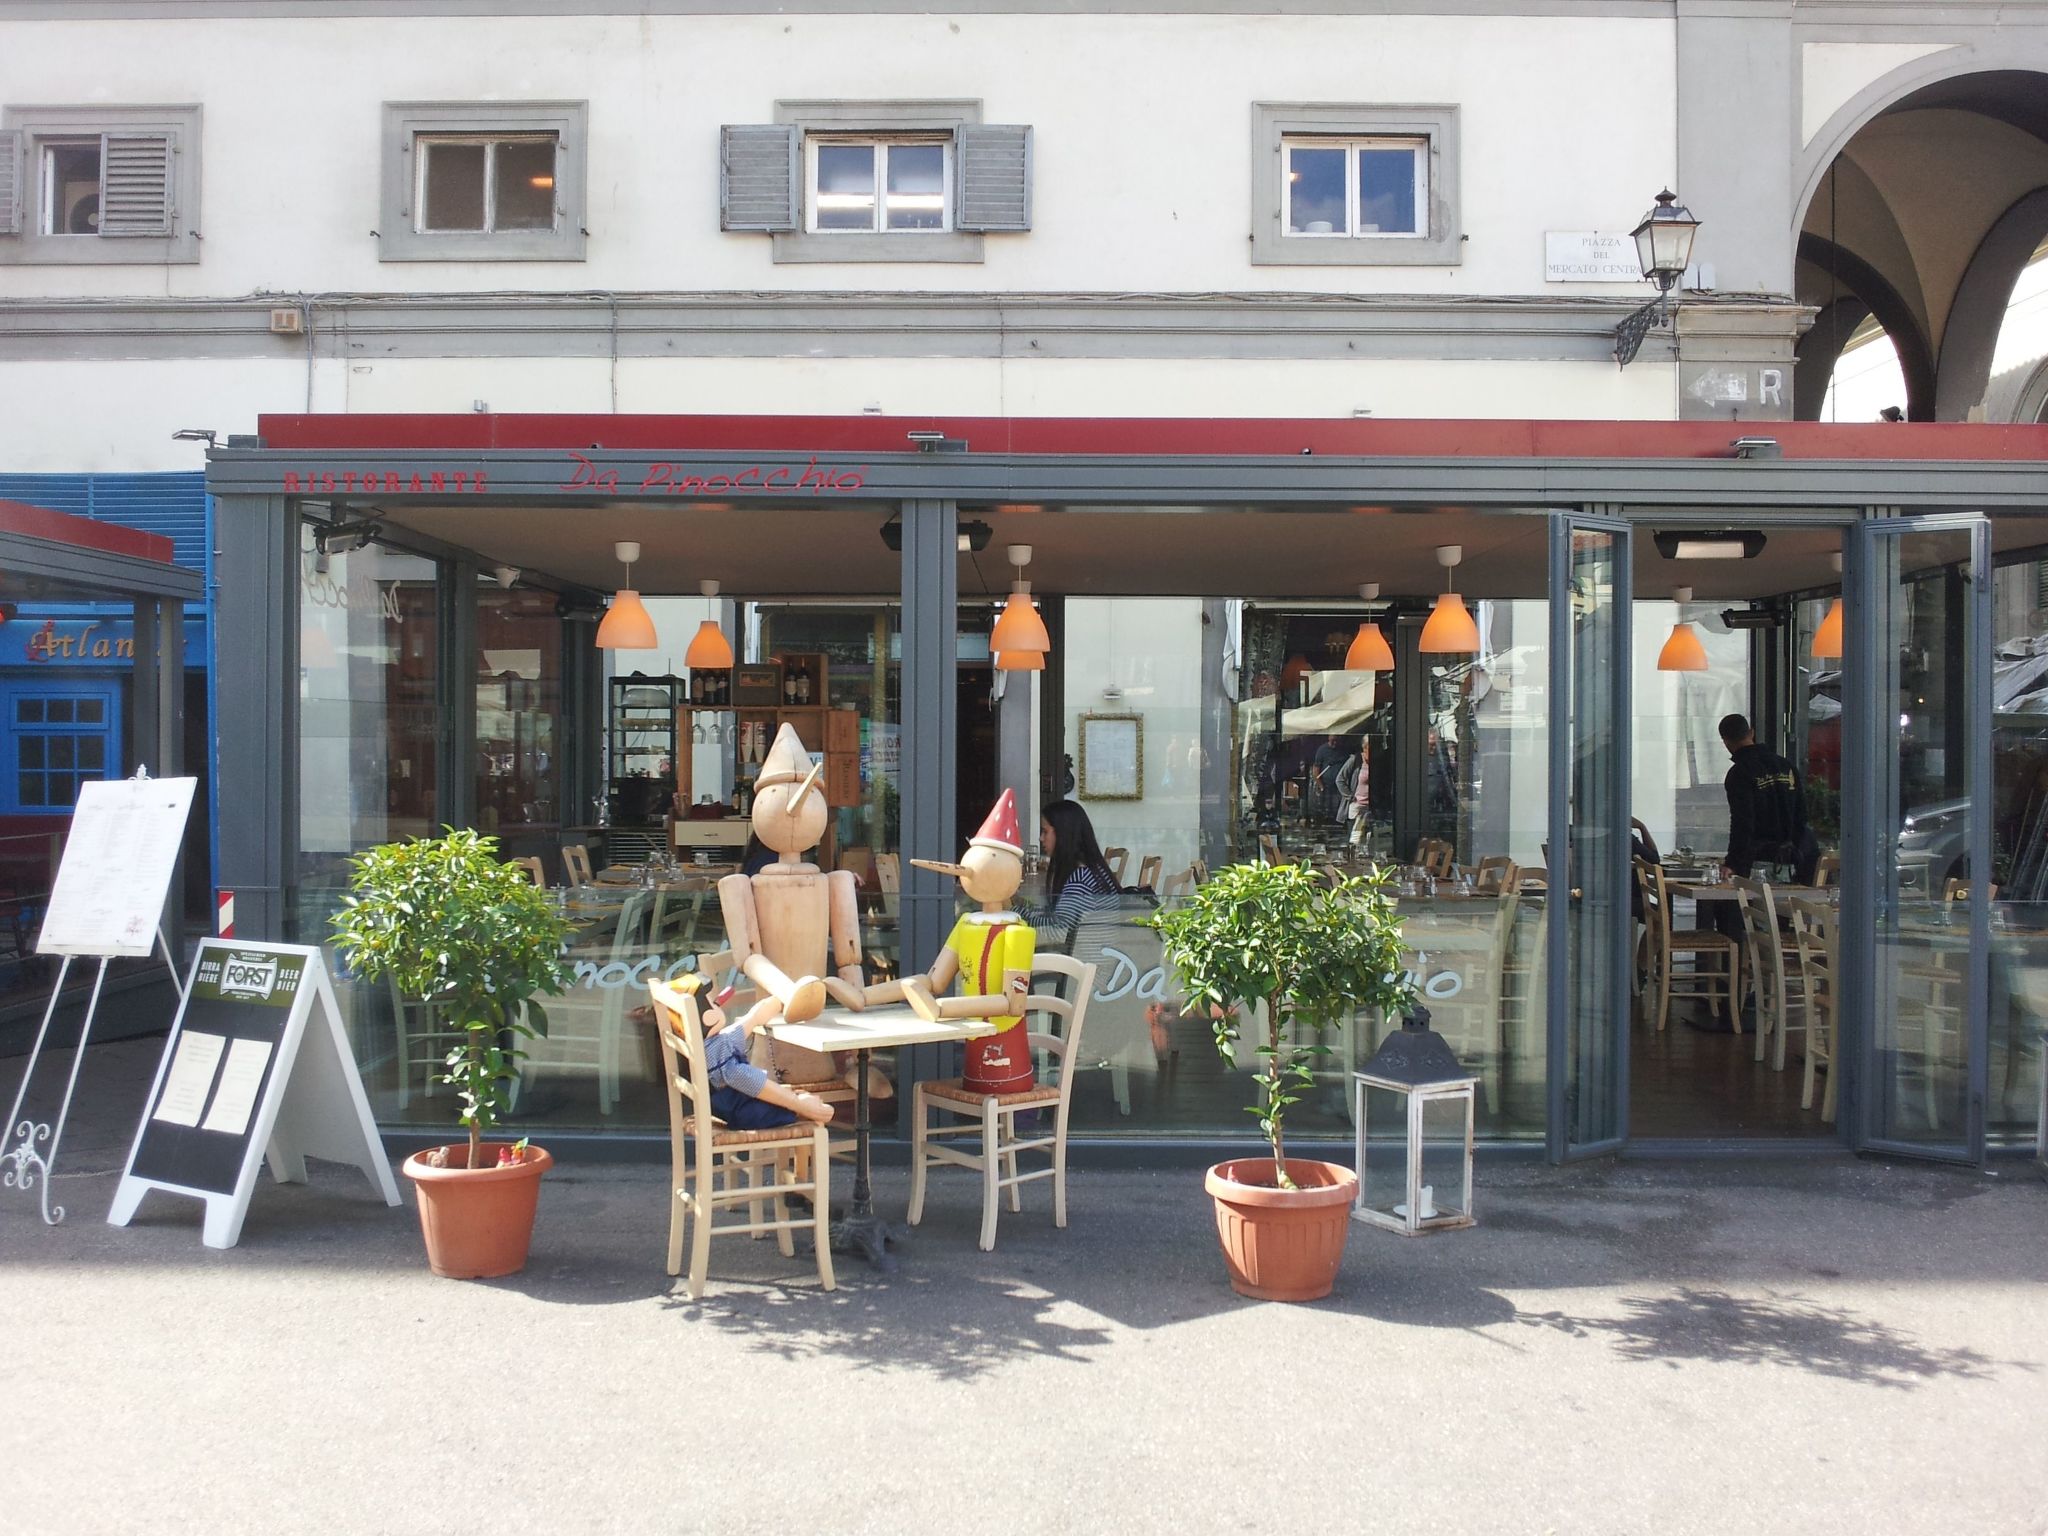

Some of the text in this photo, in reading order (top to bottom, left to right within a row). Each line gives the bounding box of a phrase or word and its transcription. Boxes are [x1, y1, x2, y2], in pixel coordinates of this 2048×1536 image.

[1581, 238, 1622, 248] PIAZZA
[1593, 251, 1610, 260] DEL
[1547, 264, 1643, 275] MERCATO CENTRA
[1759, 369, 1782, 406] R
[283, 471, 489, 494] RISTORANTE
[560, 453, 867, 495] Da Pinocchio
[30, 623, 135, 660] Atlan
[225, 964, 272, 987] FORST
[280, 968, 300, 980] BEER
[1095, 947, 1168, 1001] Da
[276, 980, 297, 992] BIER
